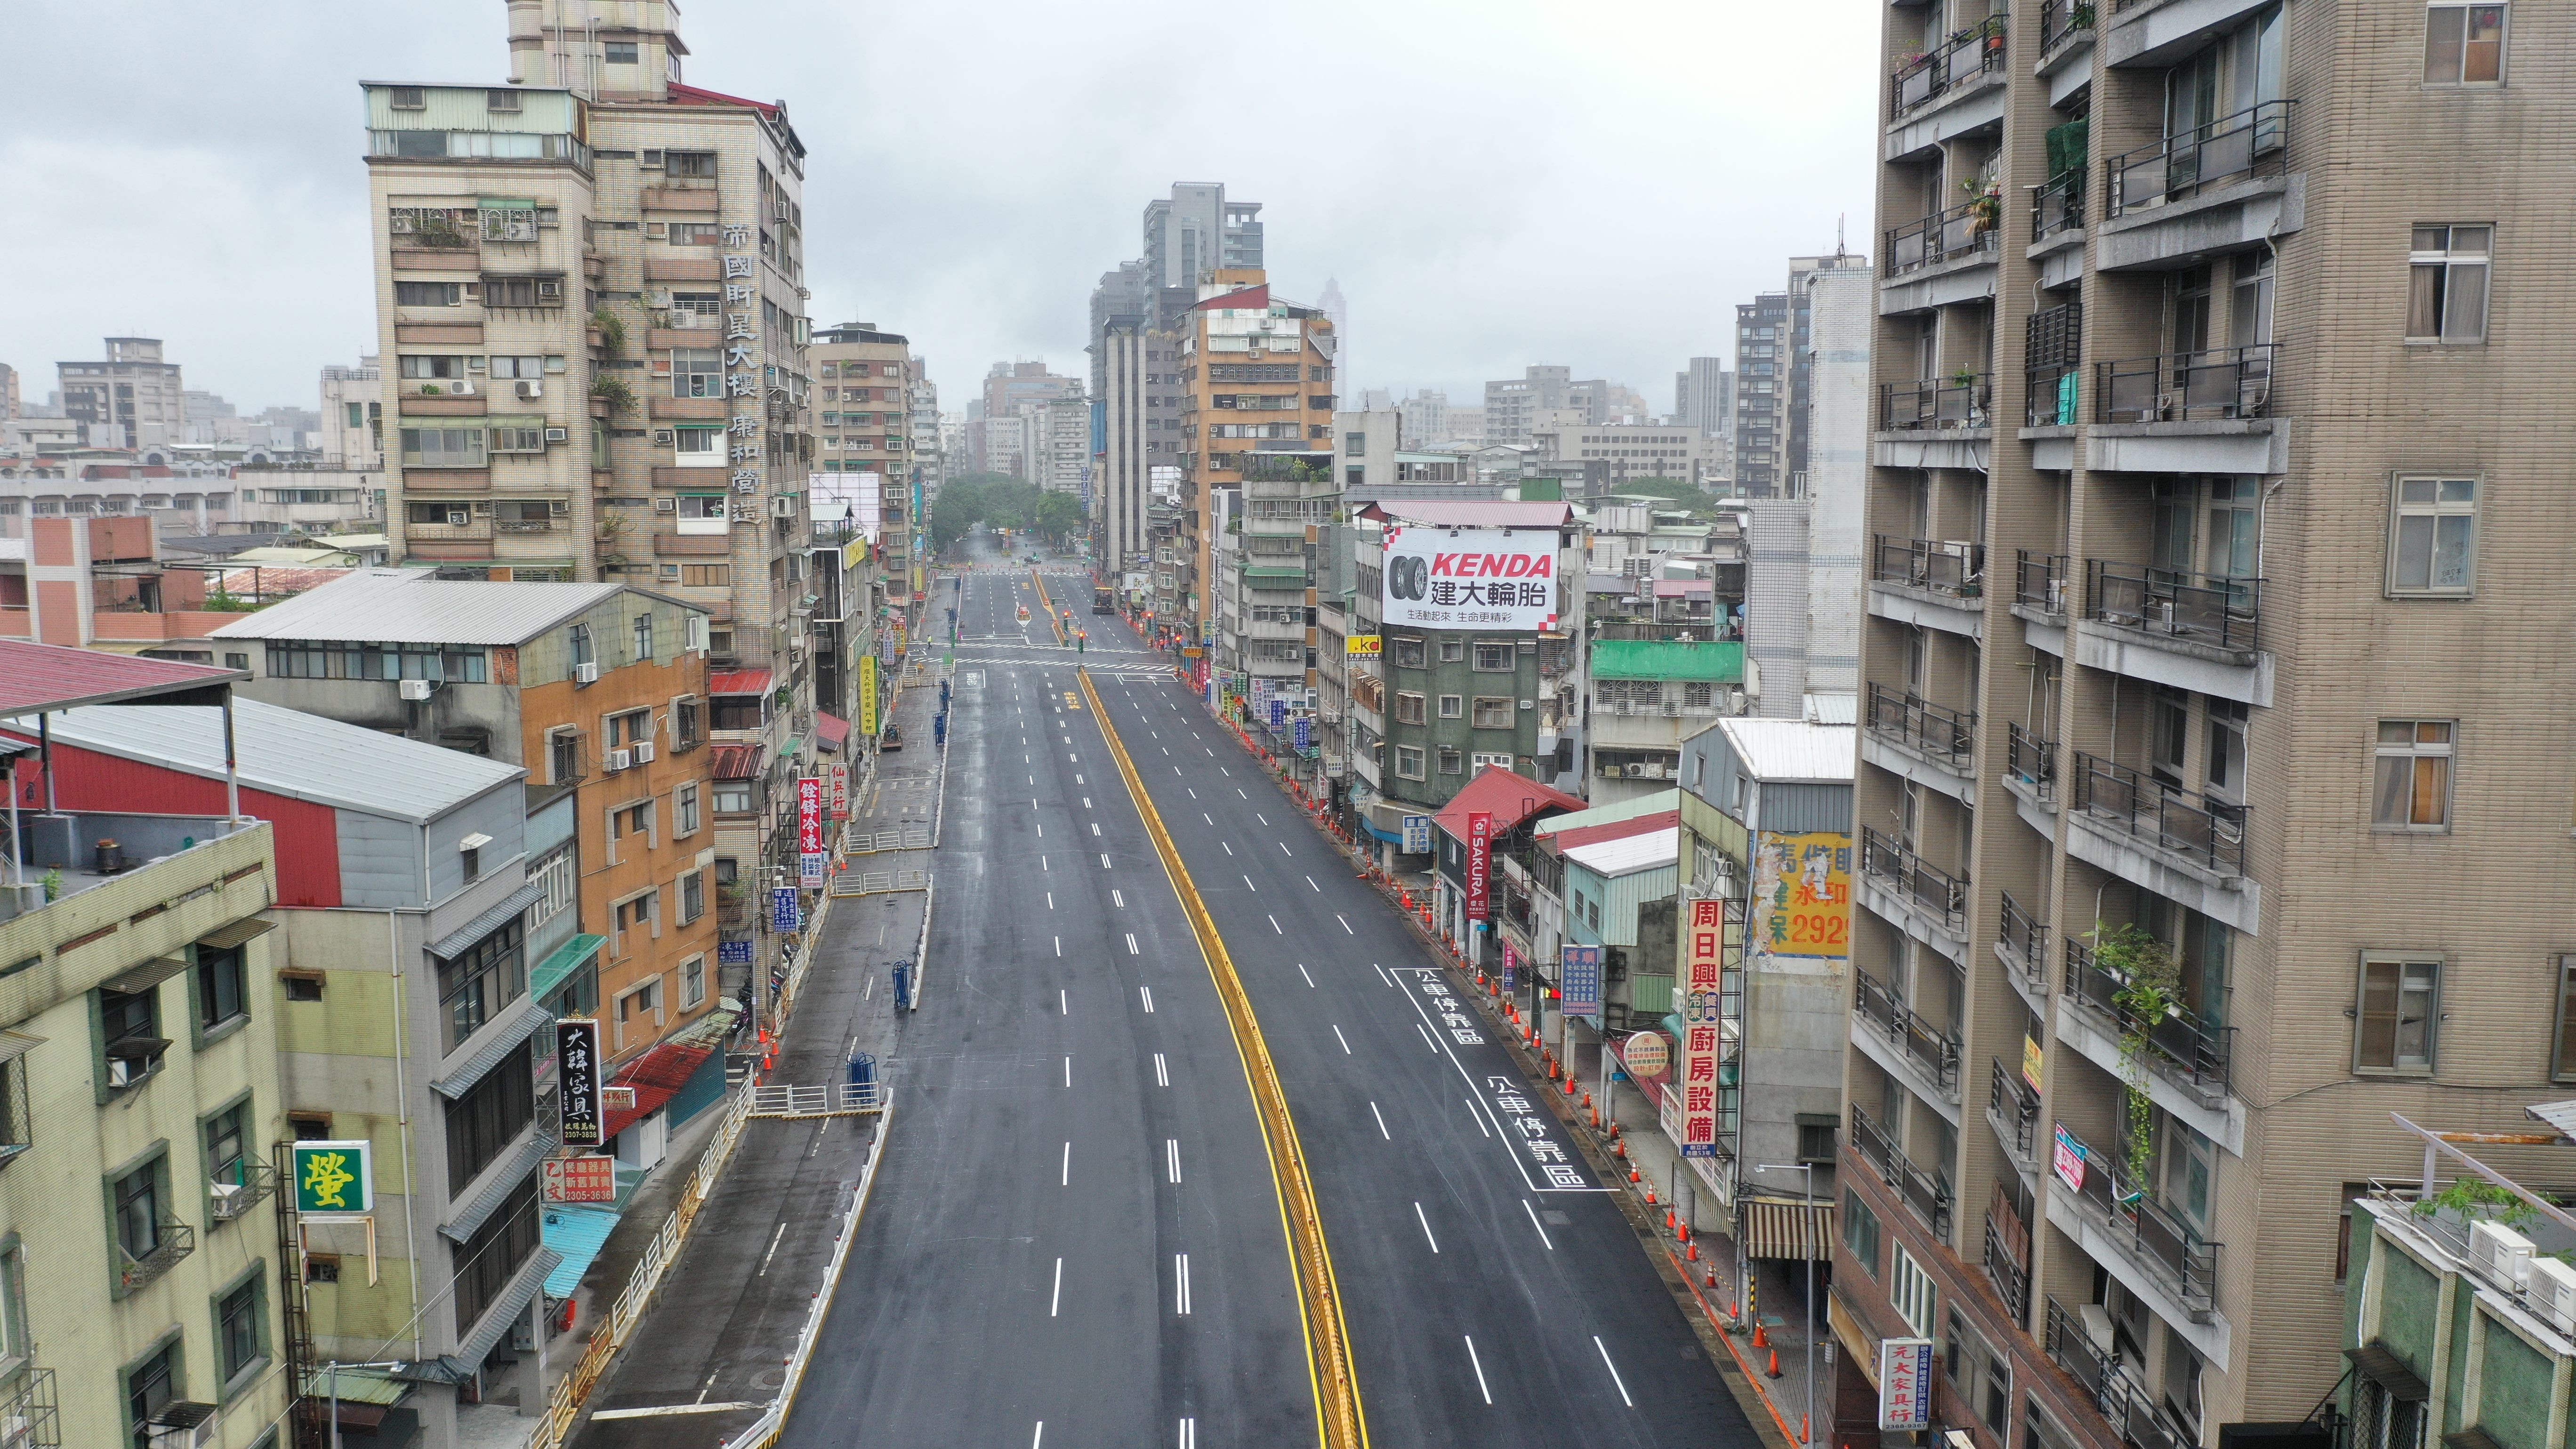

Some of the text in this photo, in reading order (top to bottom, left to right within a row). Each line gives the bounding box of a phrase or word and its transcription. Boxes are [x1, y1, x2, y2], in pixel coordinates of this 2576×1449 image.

[729, 413, 762, 526] 康和營造
[1431, 553, 1551, 578] KENDA
[1431, 581, 1546, 607] 建大輪胎
[1407, 609, 1512, 623] 生活動起來 生命更精彩
[863, 668, 871, 708] 順天科學中藥
[831, 766, 845, 809] 仙英行
[800, 782, 819, 852] 銓鋒冷凍
[1471, 837, 1484, 897] SAKURA
[1691, 901, 1718, 990] 周日興
[1415, 970, 1484, 1044] 公車停靠區
[1688, 992, 1703, 1020] 冷凍
[1704, 994, 1717, 1020] 餐具
[566, 1029, 591, 1120] 大韓家具
[1686, 1027, 1715, 1143] 廚房設備
[1487, 1076, 1587, 1188] 公車停靠區
[305, 1151, 353, 1207] 螢
[546, 1162, 563, 1200] 乙文
[565, 1161, 610, 1173] 餐廳器具
[566, 1176, 611, 1188] 新舊買賣
[566, 1191, 612, 1200] 2305-3636
[1889, 1346, 1915, 1423] 元大家具行
